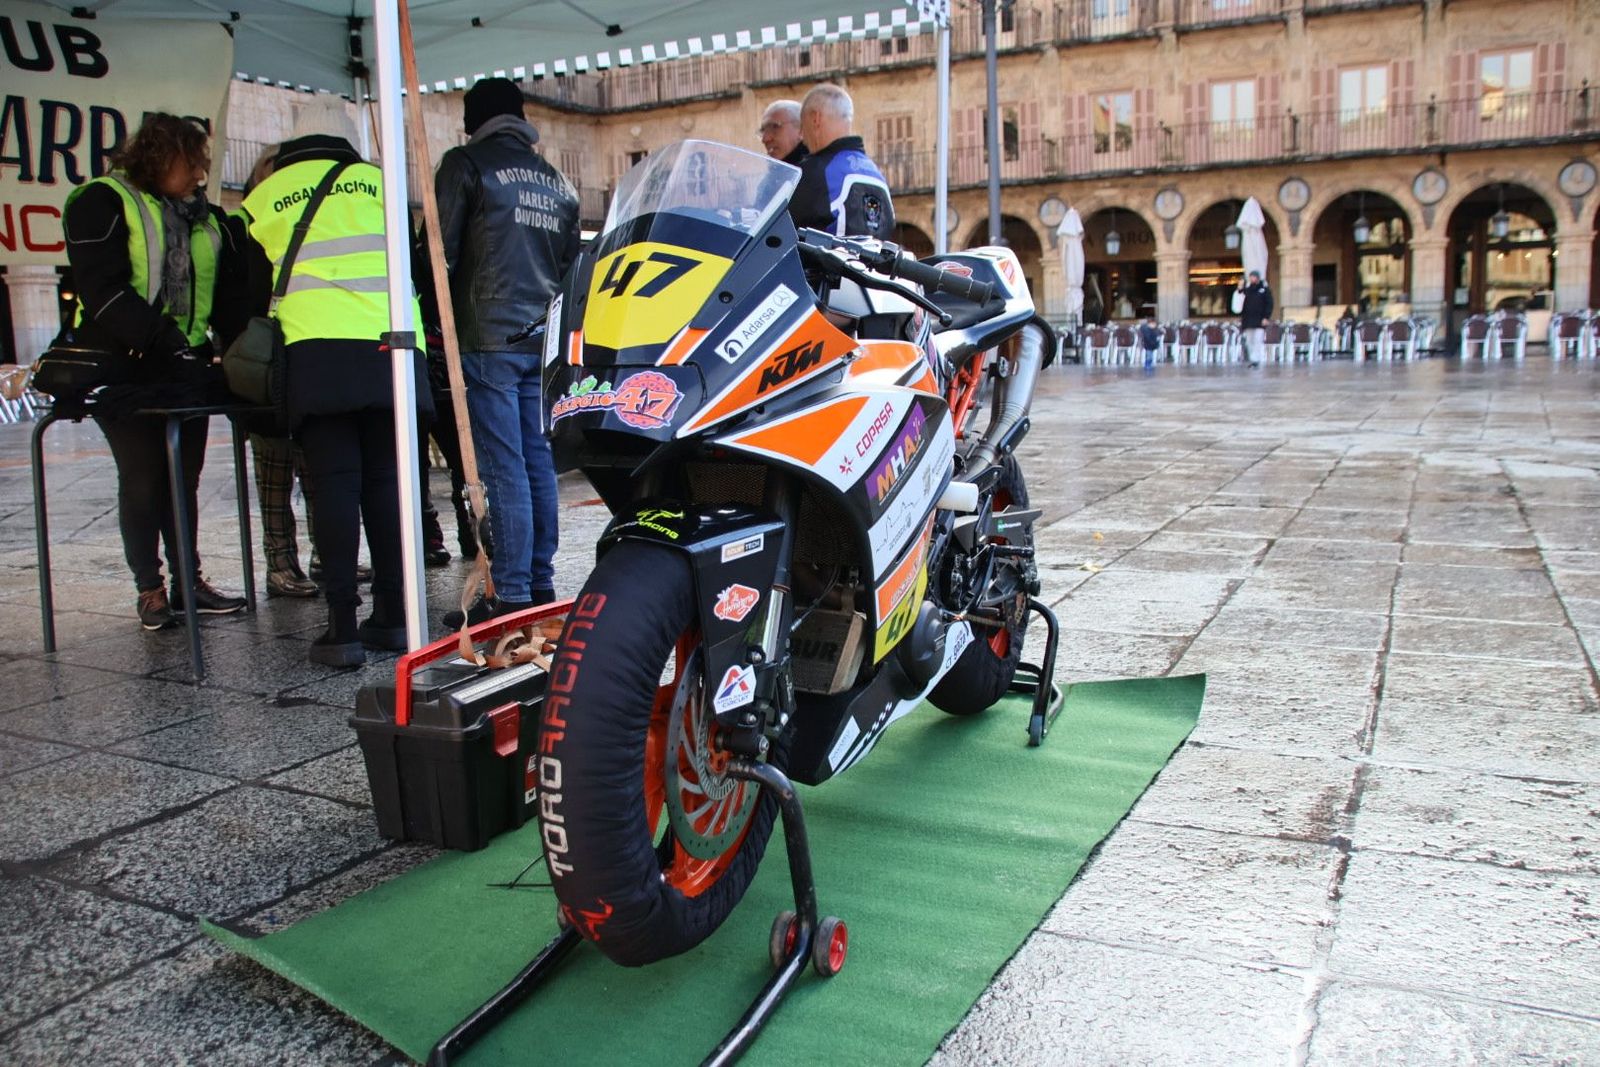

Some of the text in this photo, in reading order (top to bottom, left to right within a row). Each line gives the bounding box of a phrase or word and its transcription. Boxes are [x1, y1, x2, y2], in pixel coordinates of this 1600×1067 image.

[597, 251, 704, 298] 47
[741, 306, 776, 341] Adarsa
[756, 340, 825, 395] KTM
[615, 386, 679, 420] 47
[855, 402, 894, 458] COPASA
[540, 592, 607, 878] TORO RACING
